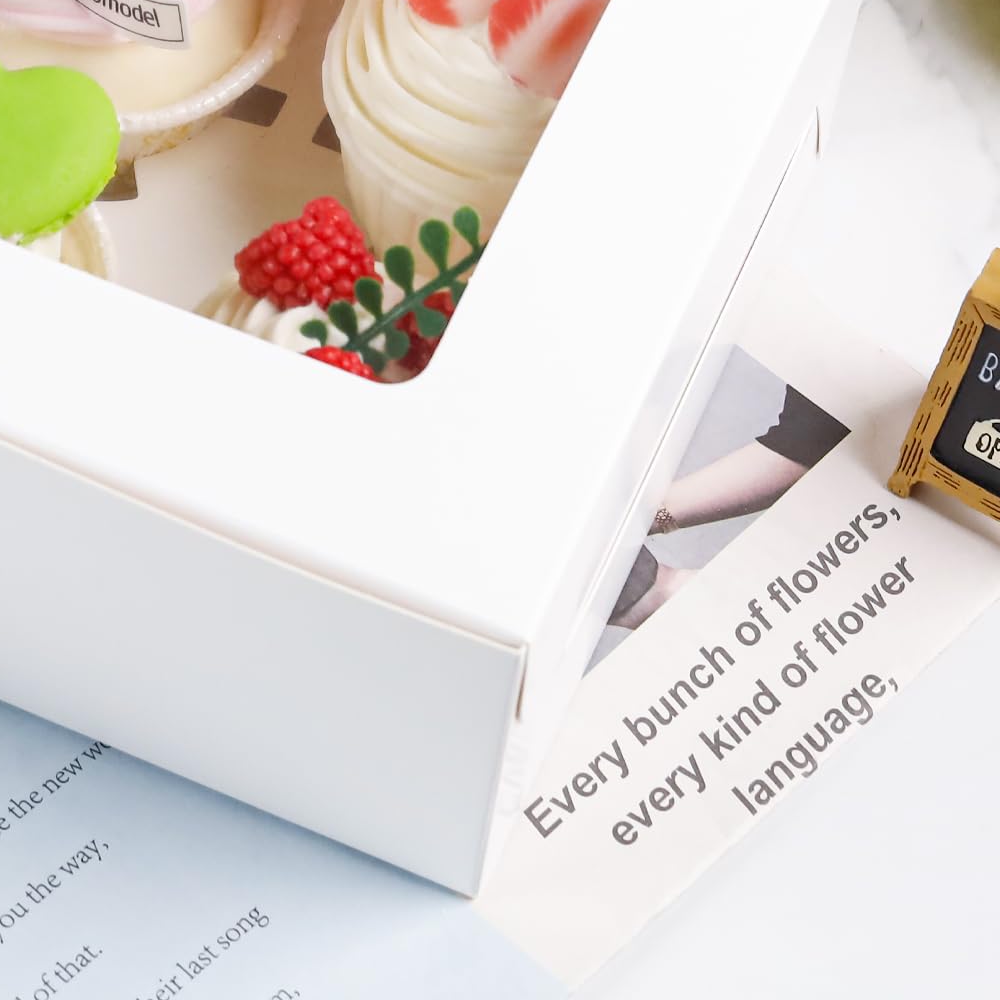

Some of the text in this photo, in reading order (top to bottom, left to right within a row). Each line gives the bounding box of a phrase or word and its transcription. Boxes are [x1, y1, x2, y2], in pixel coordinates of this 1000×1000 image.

[978, 352, 1000, 391] B
[523, 503, 901, 838] Every bunch of flowers,
[611, 556, 915, 846] every kind of flower
[731, 672, 899, 816] language,
[8, 788, 44, 820] the
[42, 756, 83, 795] new
[25, 871, 62, 905] the
[60, 837, 109, 876] way,
[33, 945, 103, 1000] of that.
[135, 906, 270, 1000] eir last song
